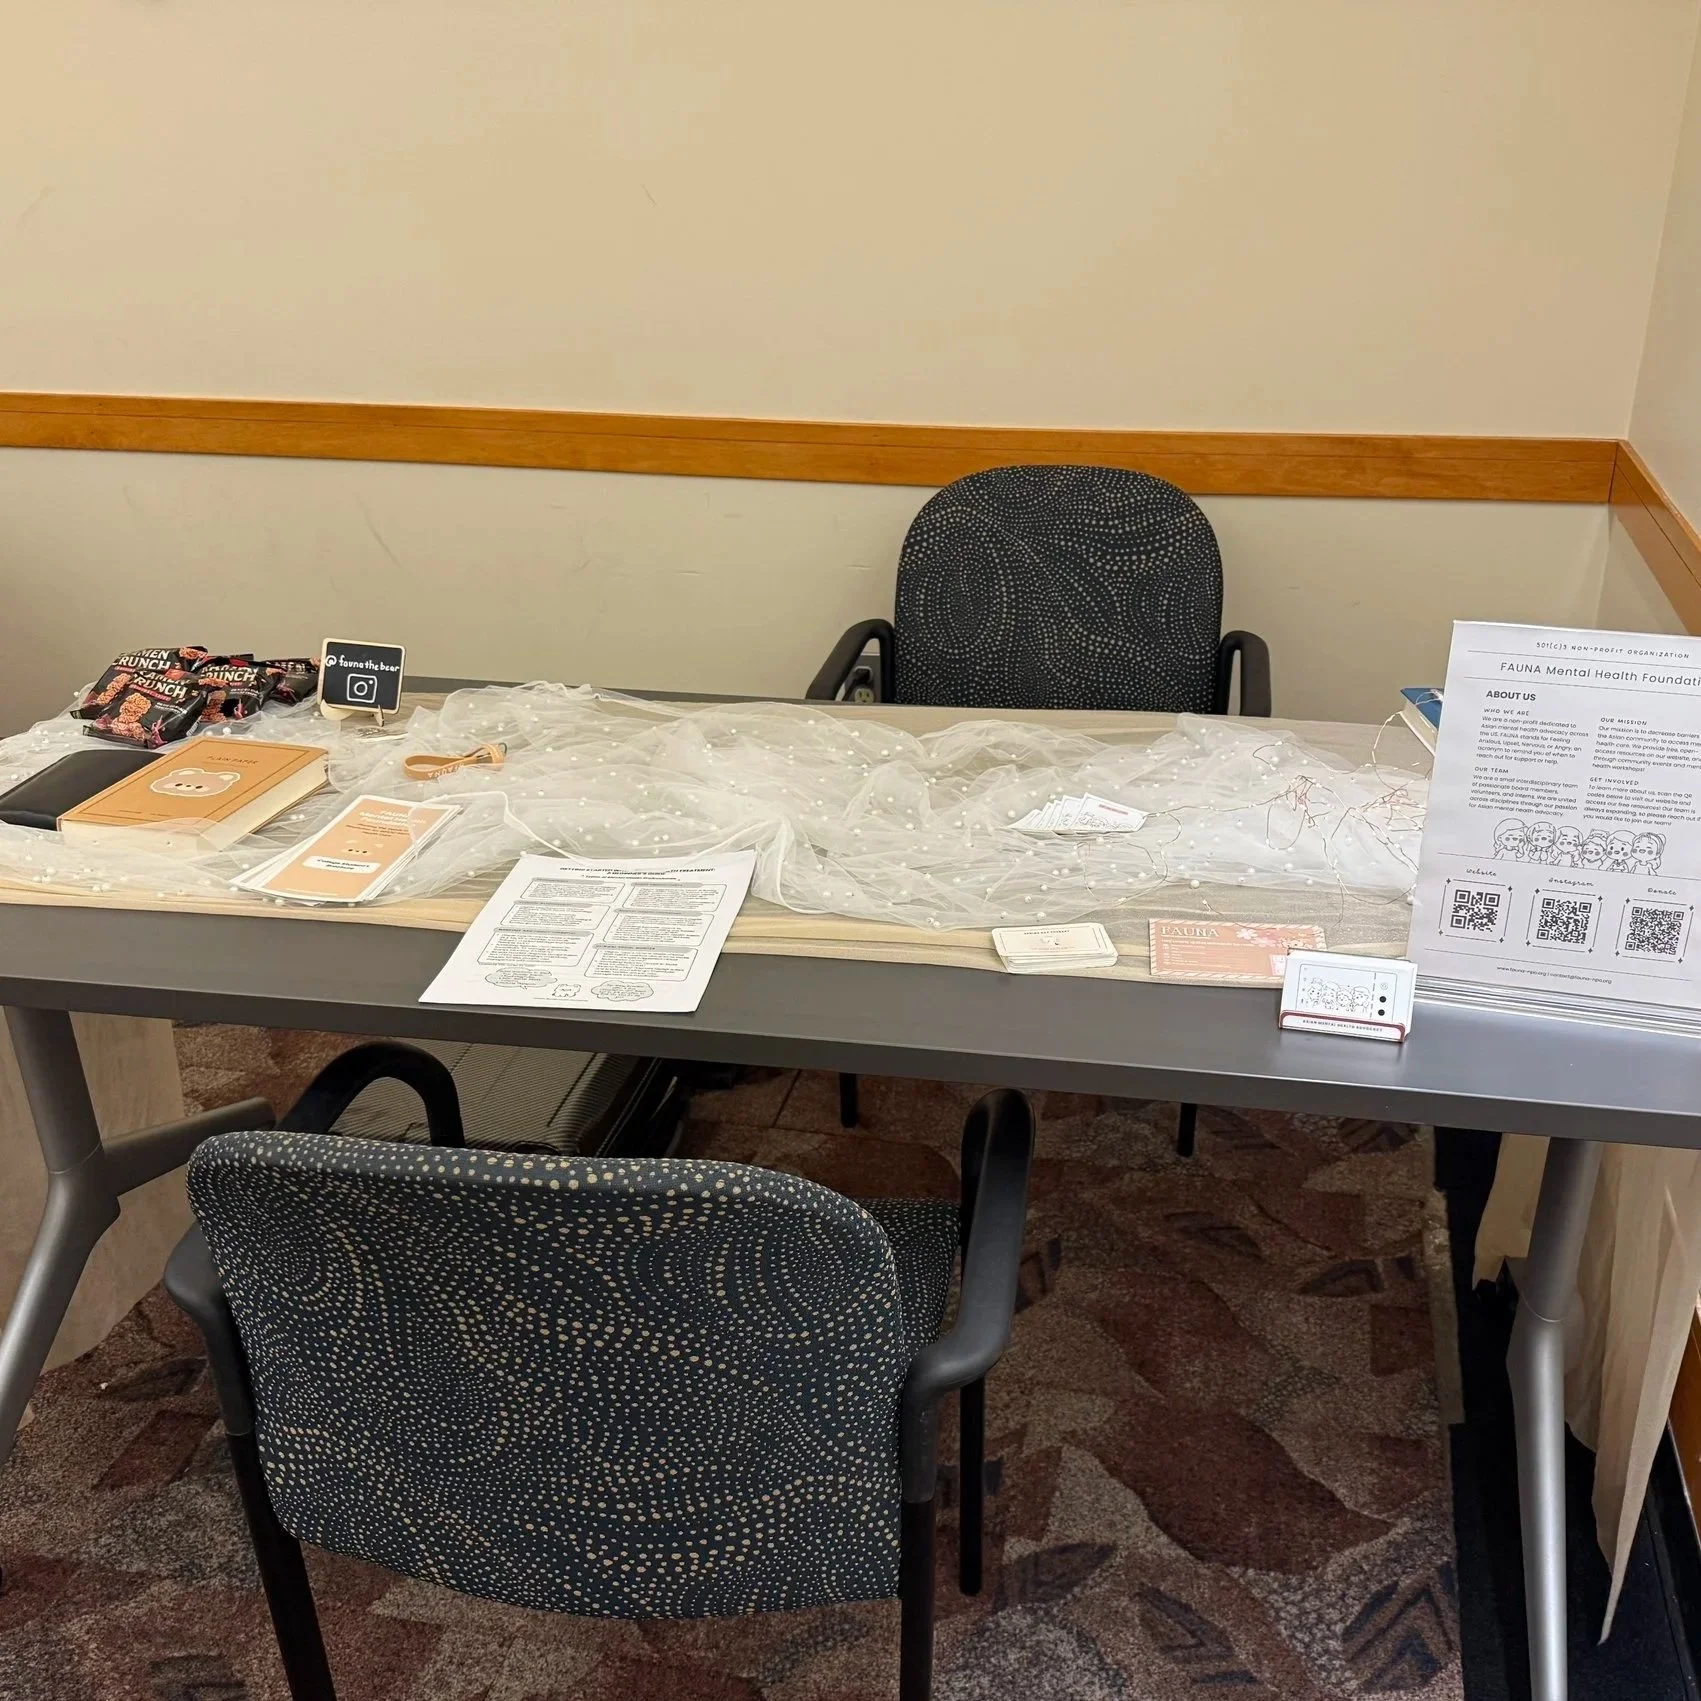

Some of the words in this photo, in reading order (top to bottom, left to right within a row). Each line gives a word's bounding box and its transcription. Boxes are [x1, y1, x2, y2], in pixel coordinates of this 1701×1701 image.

[1536, 641, 1568, 651] 501(C)3
[1571, 645, 1624, 654] NON-PROFIT
[1627, 649, 1690, 659] ORGANIZATION
[1500, 661, 1542, 675] FAUNA
[1546, 665, 1591, 678] Mental
[1595, 669, 1638, 682] Health
[1642, 672, 1701, 688] Foundati
[1485, 689, 1522, 700] ABOUT
[1522, 691, 1537, 701] US
[1605, 778, 1639, 786] INVOLVED
[1465, 868, 1497, 877] Website
[1548, 876, 1595, 887] Instagram
[1647, 886, 1678, 896] Donate
[1161, 926, 1219, 937] FAUNA
